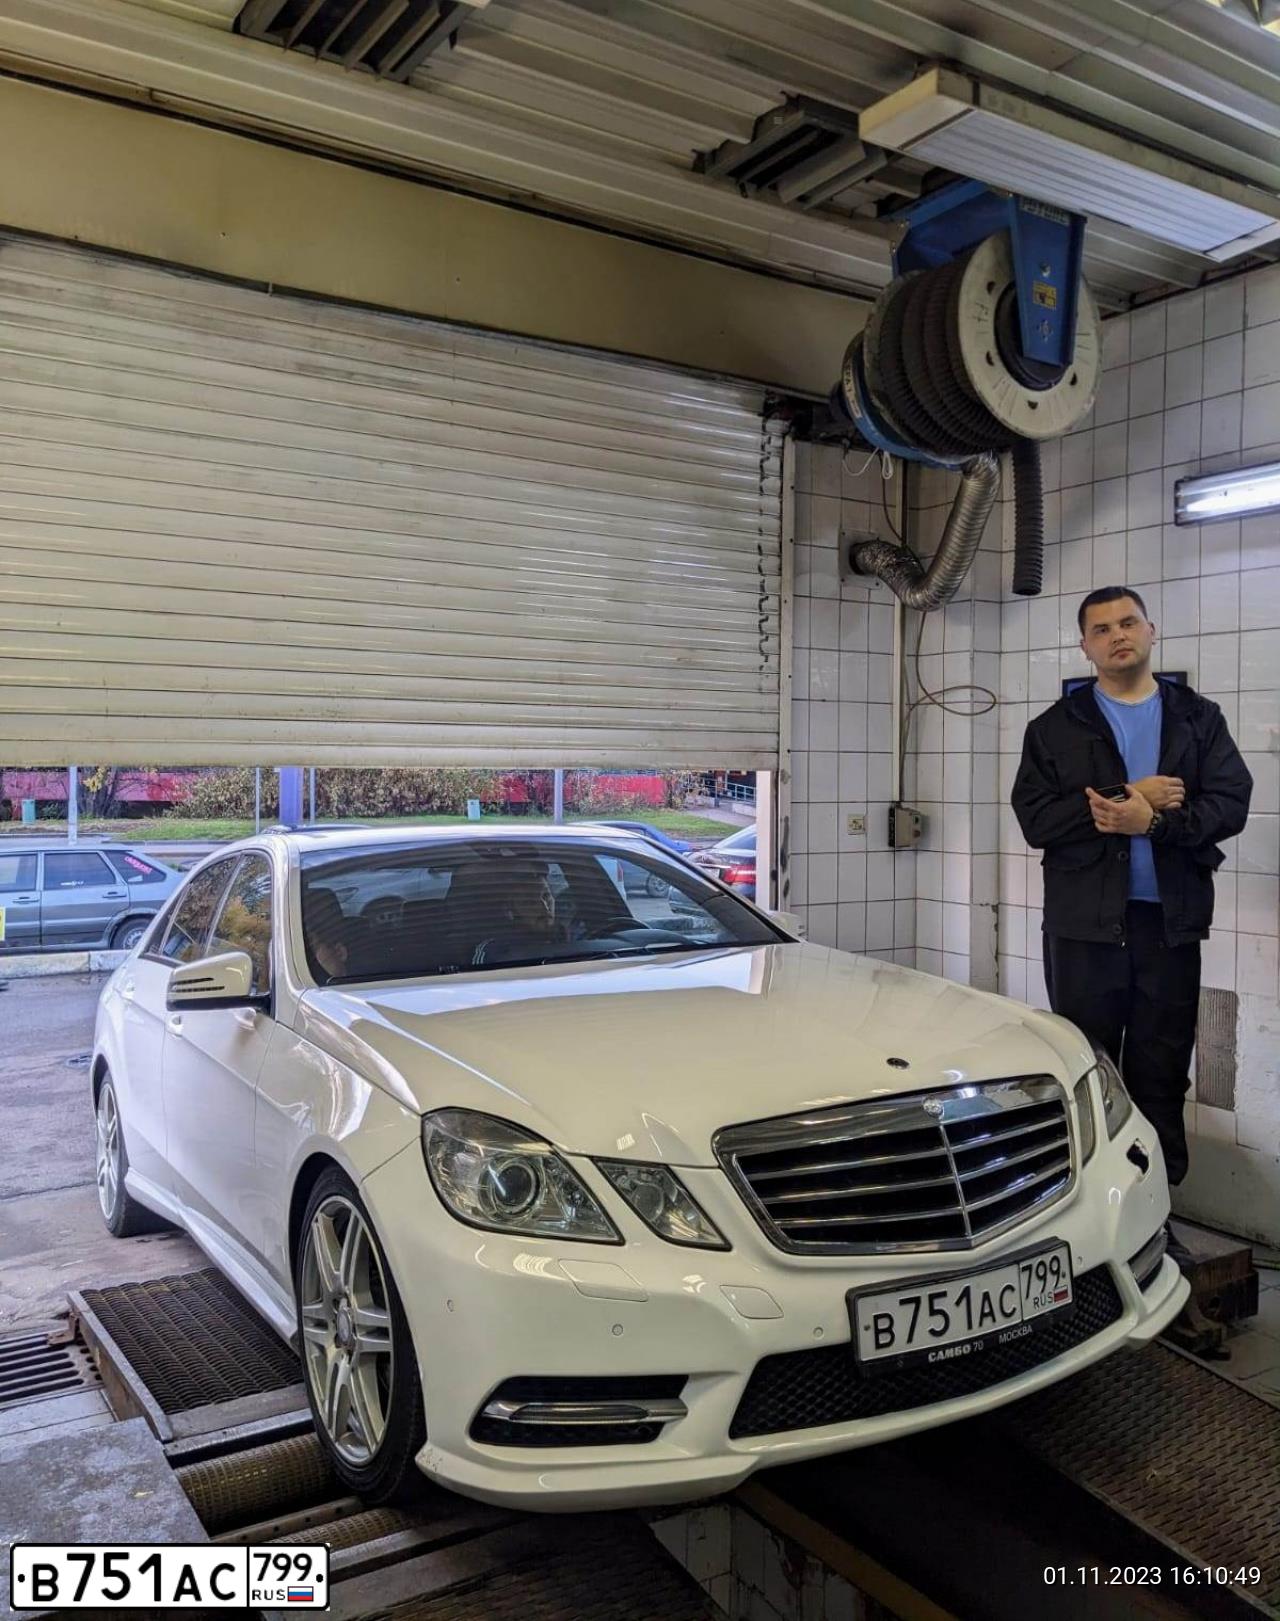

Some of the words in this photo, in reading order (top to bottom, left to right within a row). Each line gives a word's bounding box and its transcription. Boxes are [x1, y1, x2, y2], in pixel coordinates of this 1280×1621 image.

[873, 1285, 1016, 1350] В751АС
[1021, 1255, 1061, 1300] 799
[1033, 1293, 1053, 1310] RUS
[999, 1325, 1033, 1345] МОСКВА
[928, 1344, 971, 1363] САМБО
